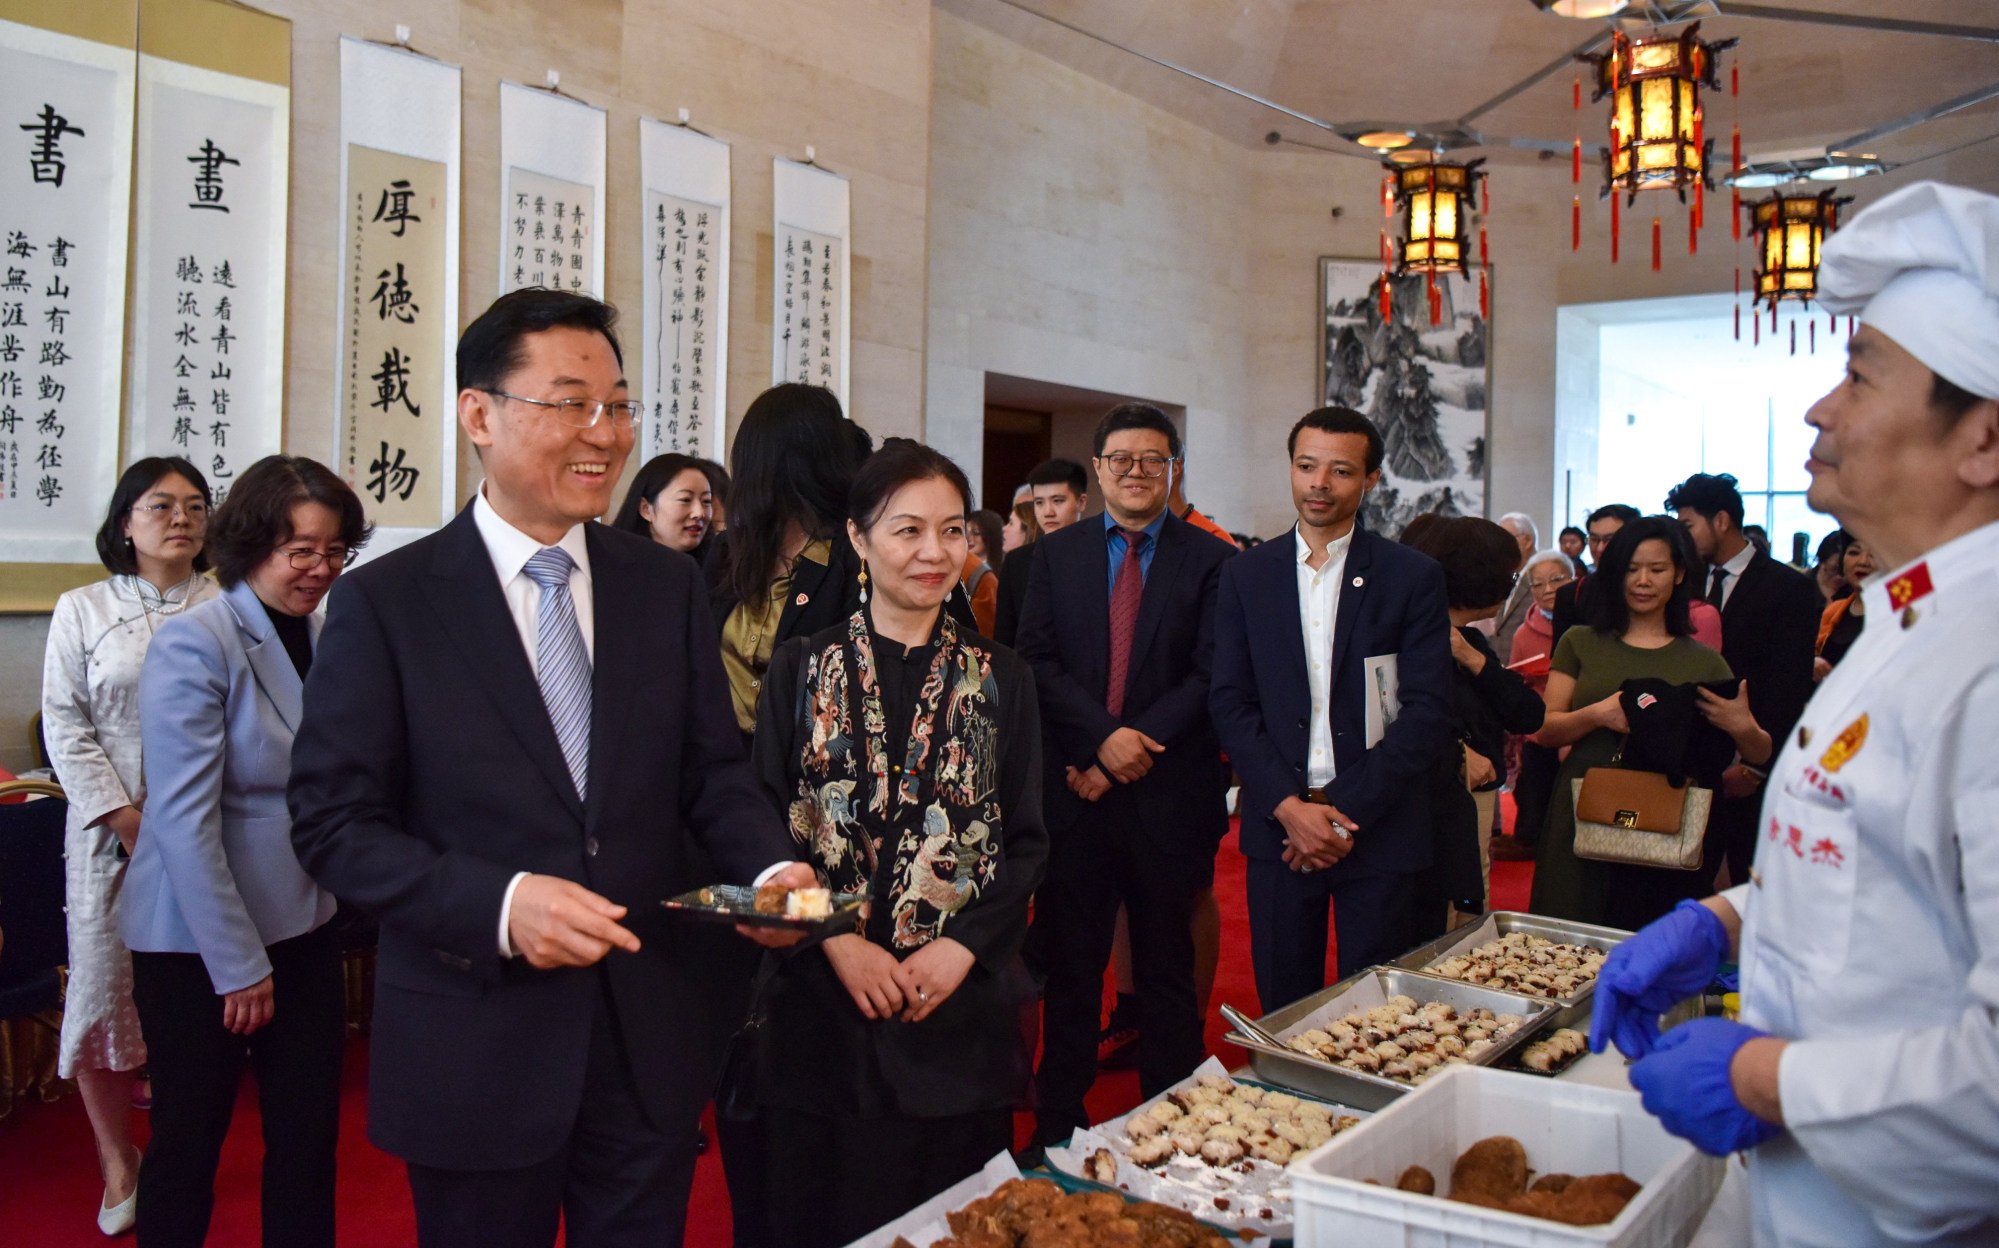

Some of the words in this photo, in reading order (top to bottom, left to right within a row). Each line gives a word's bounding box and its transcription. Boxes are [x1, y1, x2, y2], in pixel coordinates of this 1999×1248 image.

[19, 103, 86, 189] 書
[187, 138, 241, 214] 畫
[513, 193, 529, 285] 不努力老
[0, 230, 38, 435] 海無涯苦作舟
[172, 255, 203, 448] 聽流水全無聲
[366, 179, 422, 505] 厚德載物
